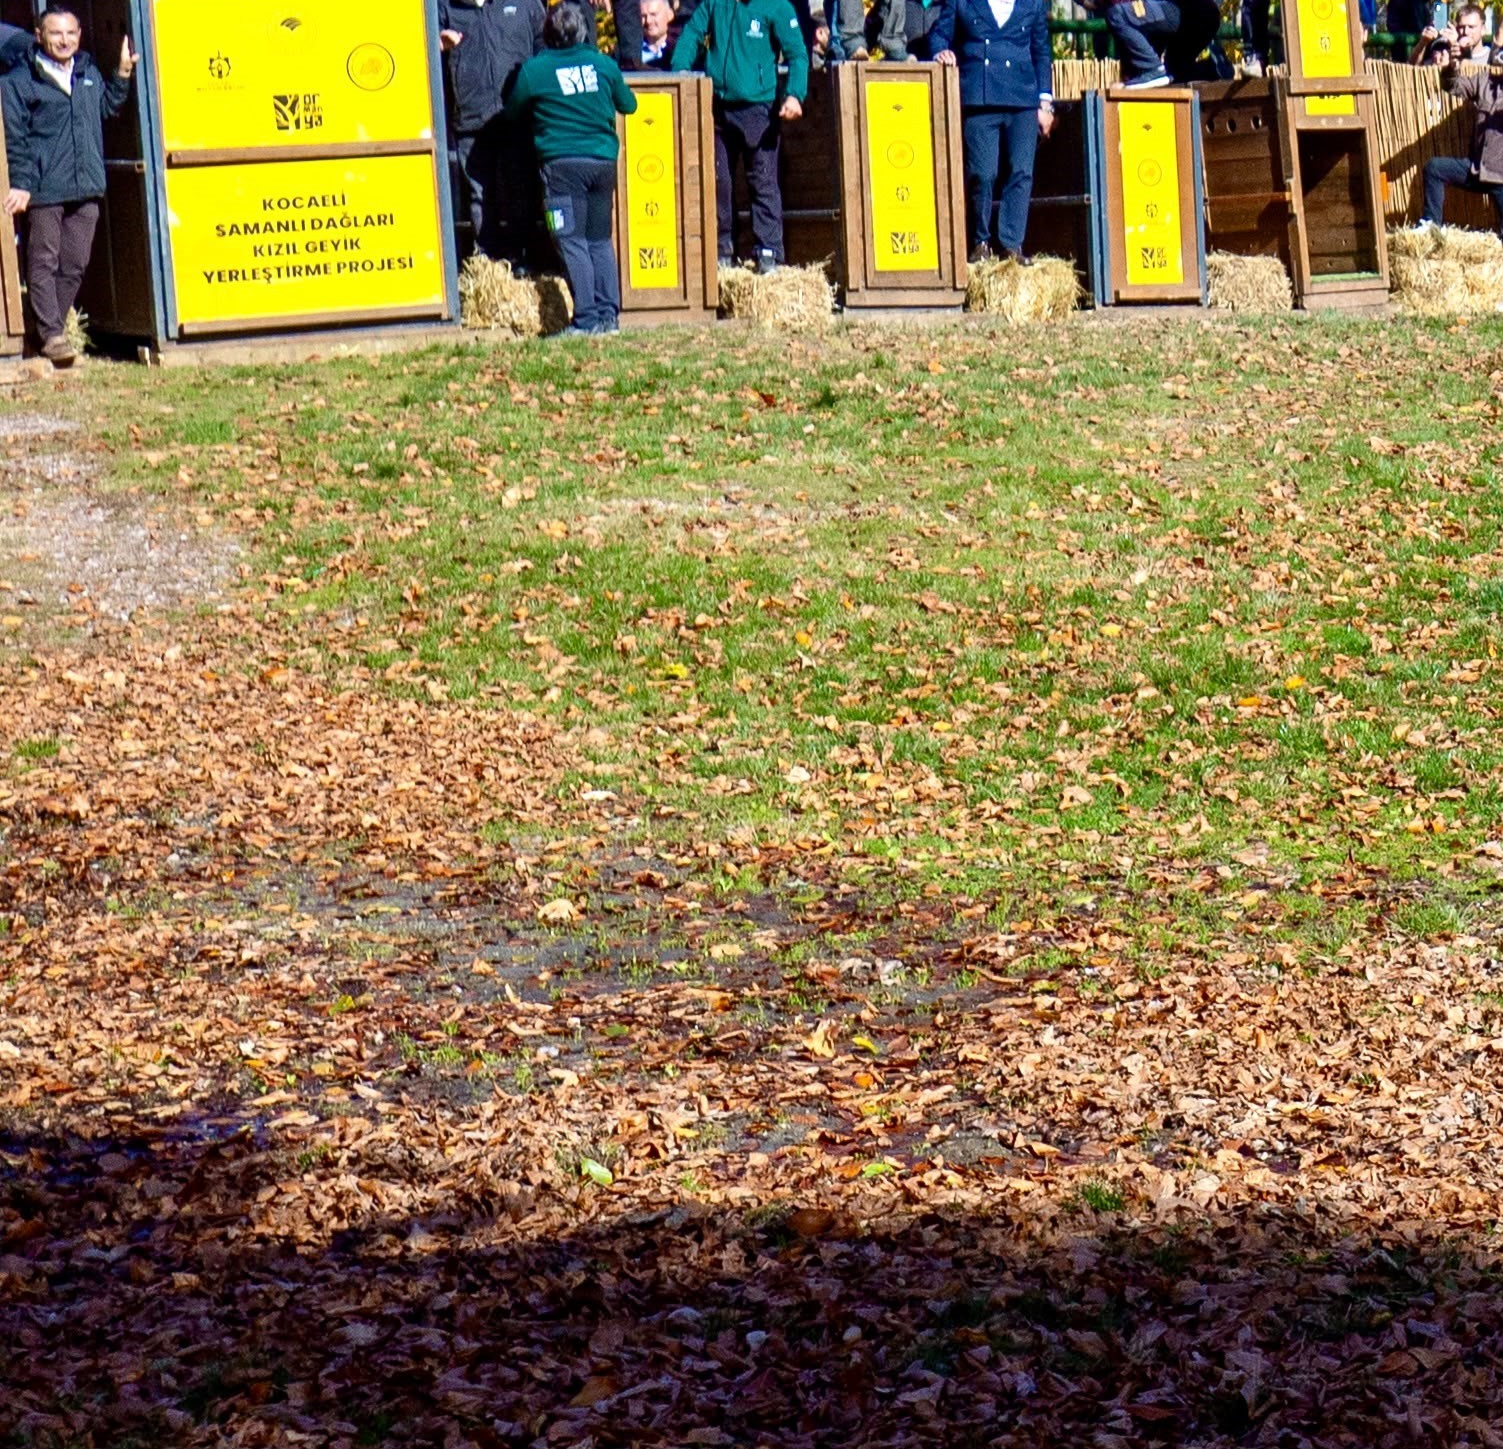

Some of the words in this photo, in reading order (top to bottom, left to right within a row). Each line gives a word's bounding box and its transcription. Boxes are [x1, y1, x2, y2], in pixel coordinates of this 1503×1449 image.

[262, 190, 346, 211] KOCAELİ
[215, 219, 306, 238] SAMANLI
[310, 212, 394, 231] DAĞLARI
[253, 243, 300, 258] KIZIL
[305, 236, 361, 254] GEYİK
[203, 261, 332, 284] YERLEŞTİRME
[336, 253, 414, 274] PROJESİ
